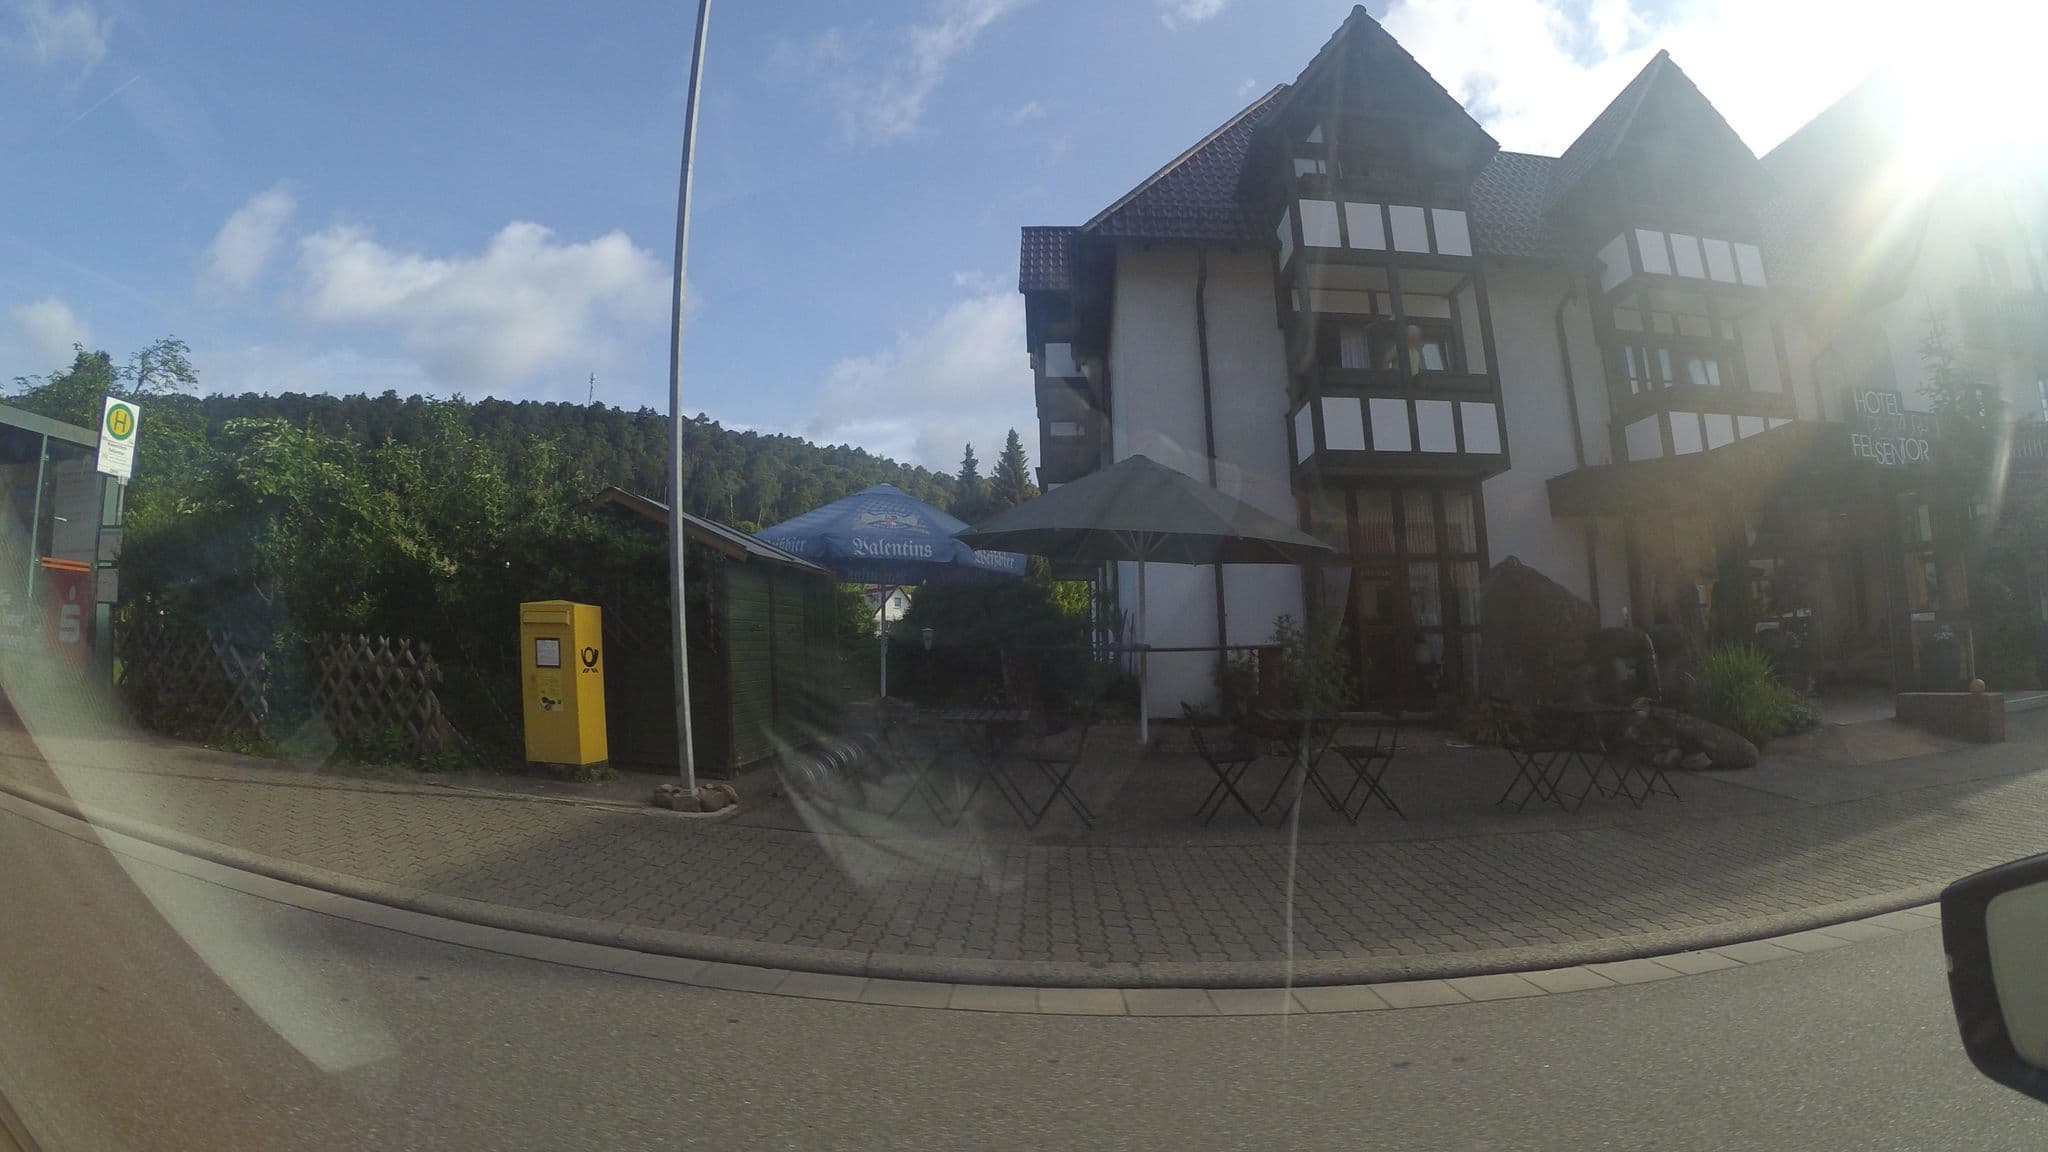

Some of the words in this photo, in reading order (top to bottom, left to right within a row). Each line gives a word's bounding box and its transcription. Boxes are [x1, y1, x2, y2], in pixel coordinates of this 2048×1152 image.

[1854, 390, 1905, 416] HOTEL
[114, 410, 127, 433] H
[1850, 432, 1930, 465] FELSENTOR
[851, 536, 933, 558] Valentins
